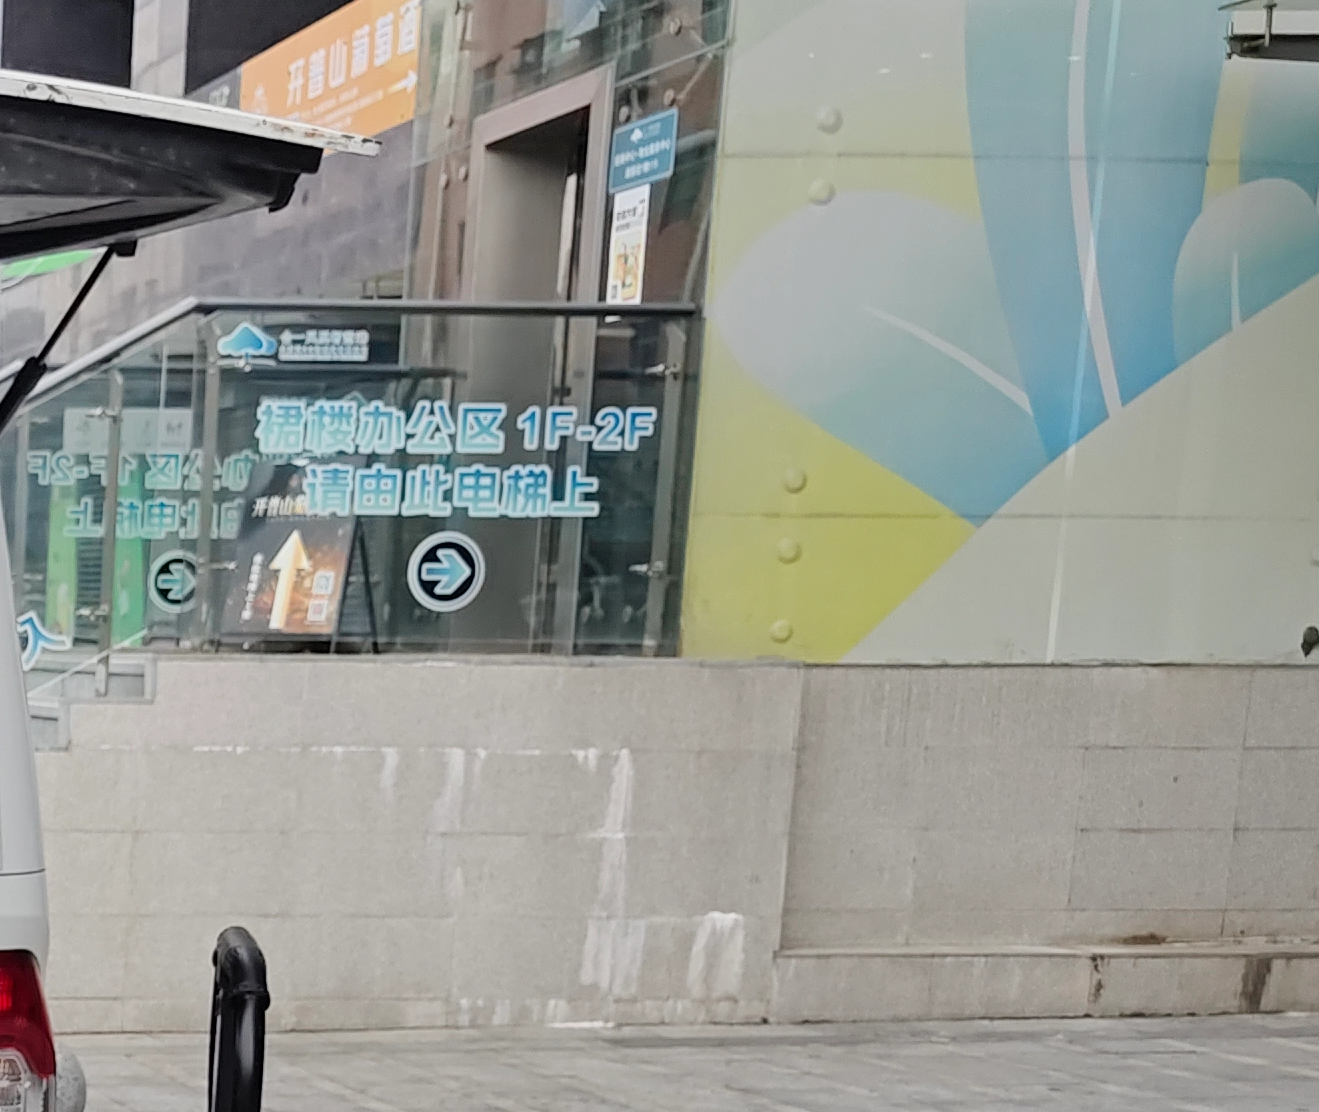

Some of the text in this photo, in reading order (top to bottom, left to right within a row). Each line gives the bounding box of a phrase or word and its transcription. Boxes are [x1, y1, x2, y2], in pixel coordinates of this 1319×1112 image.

[255, 401, 658, 455] 裙楼办公区 1F-2F
[303, 463, 600, 518] 请由此电梯上
